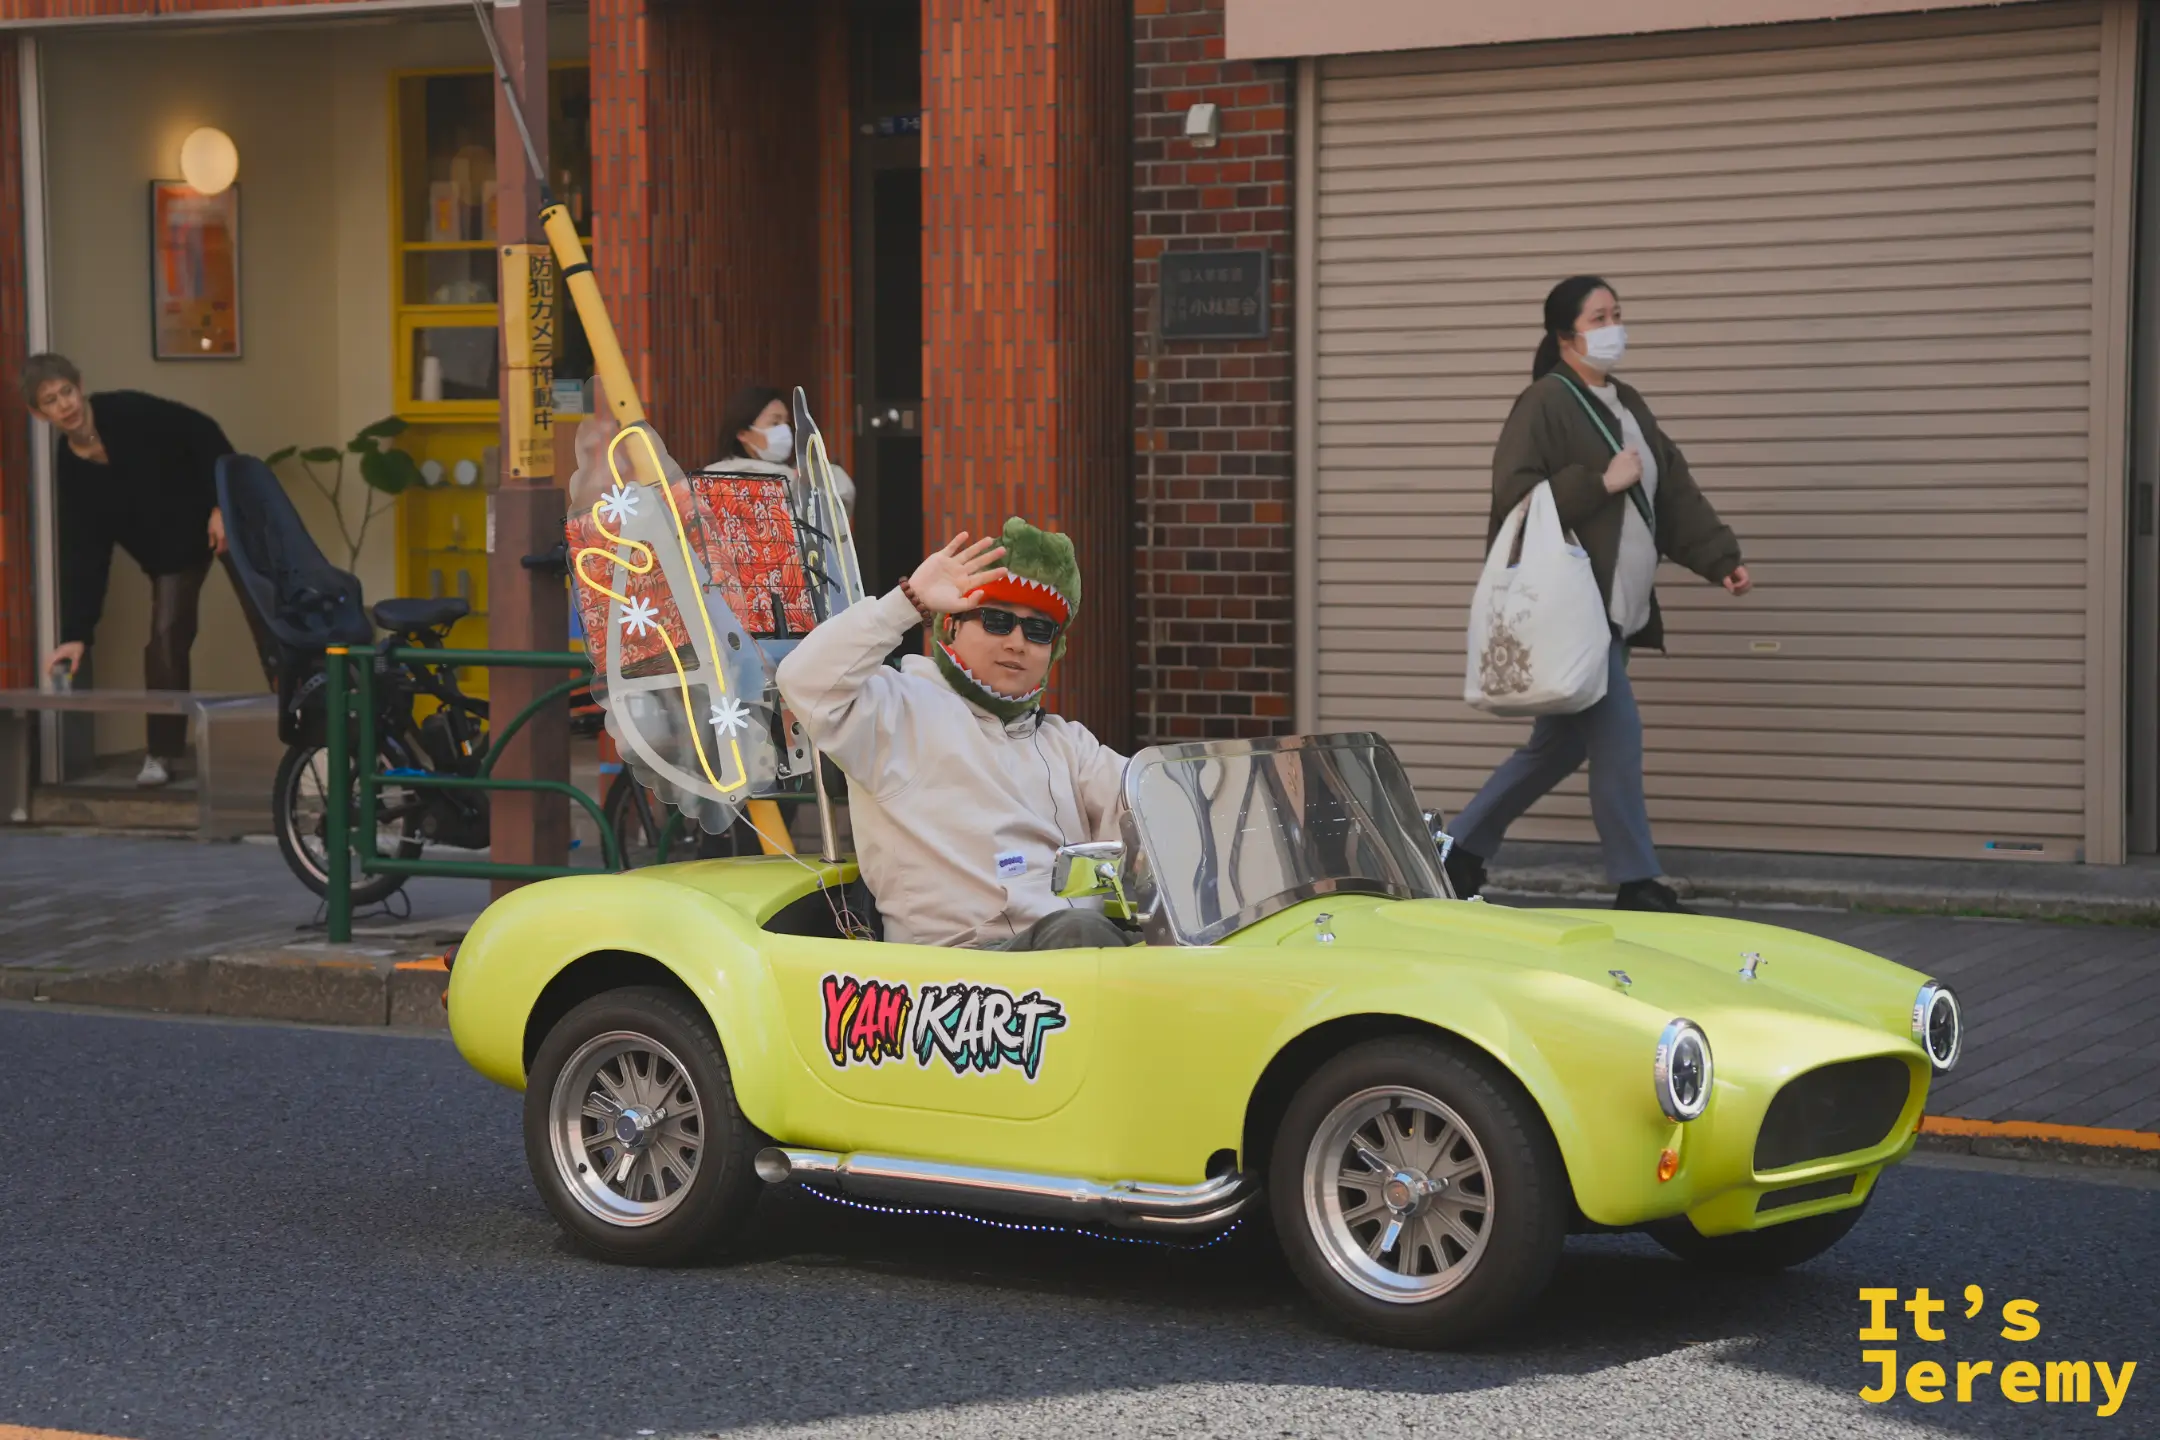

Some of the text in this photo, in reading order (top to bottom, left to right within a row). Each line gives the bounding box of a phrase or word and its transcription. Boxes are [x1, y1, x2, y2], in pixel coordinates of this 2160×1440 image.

[528, 255, 553, 431] 防犯カメラ作動中
[912, 983, 1066, 1079] KART
